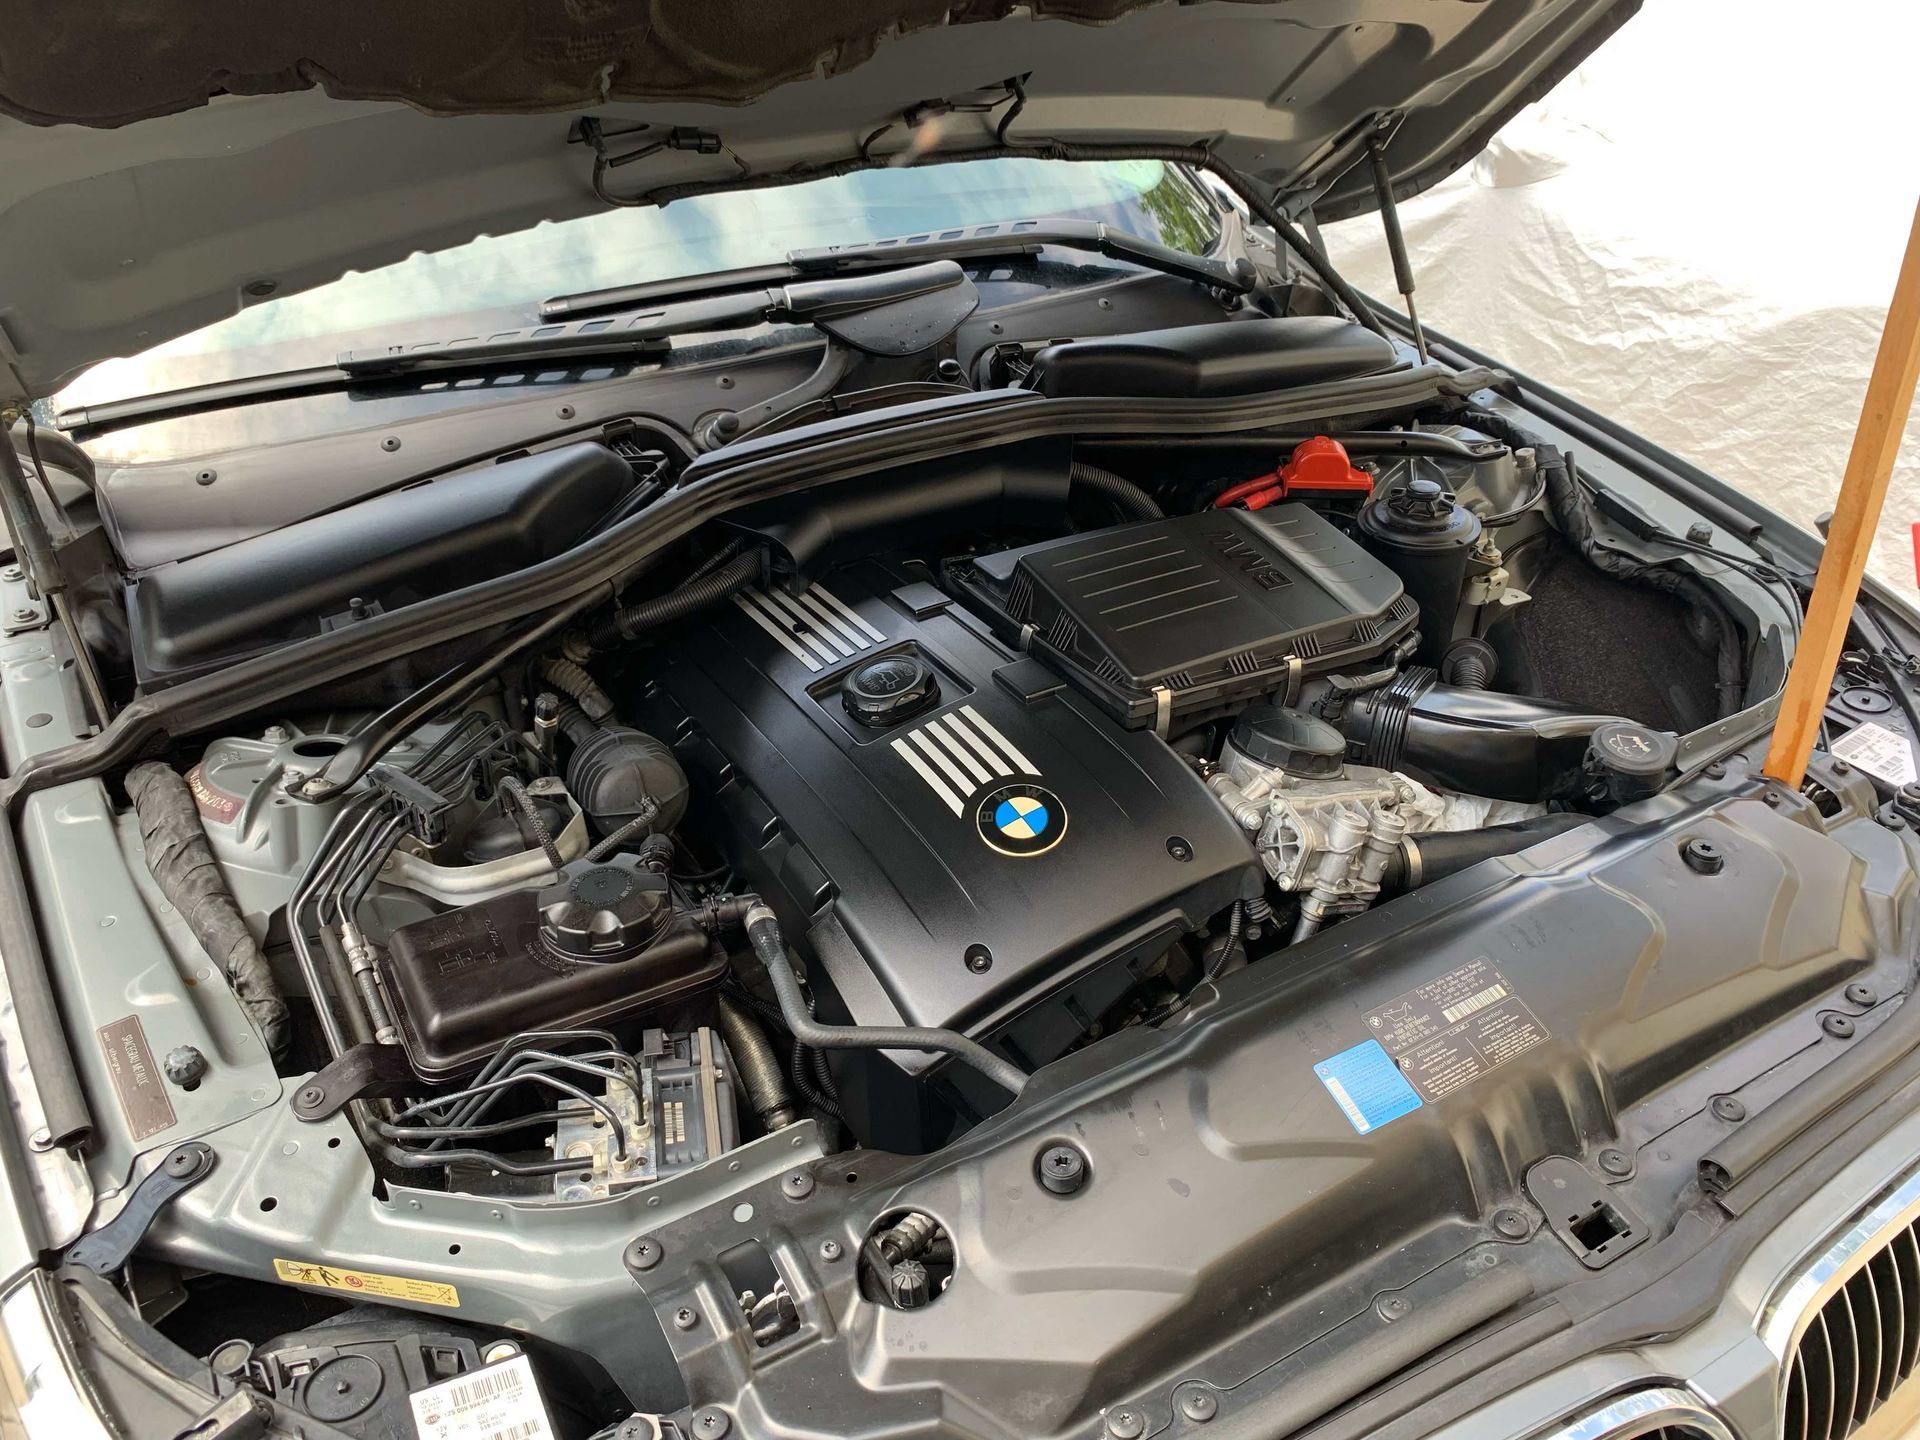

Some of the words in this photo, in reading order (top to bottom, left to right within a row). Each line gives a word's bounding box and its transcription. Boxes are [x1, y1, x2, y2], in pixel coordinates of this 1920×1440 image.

[1200, 528, 1294, 590] BMW
[980, 786, 1043, 822] BMW
[1477, 1008, 1504, 1026] Attention!
[1489, 1024, 1516, 1041] Important!
[1416, 1039, 1444, 1058] Attention!
[122, 1033, 140, 1064] SPACEGRAU
[132, 1062, 149, 1087] METALLIC
[1429, 1056, 1457, 1073] Important!
